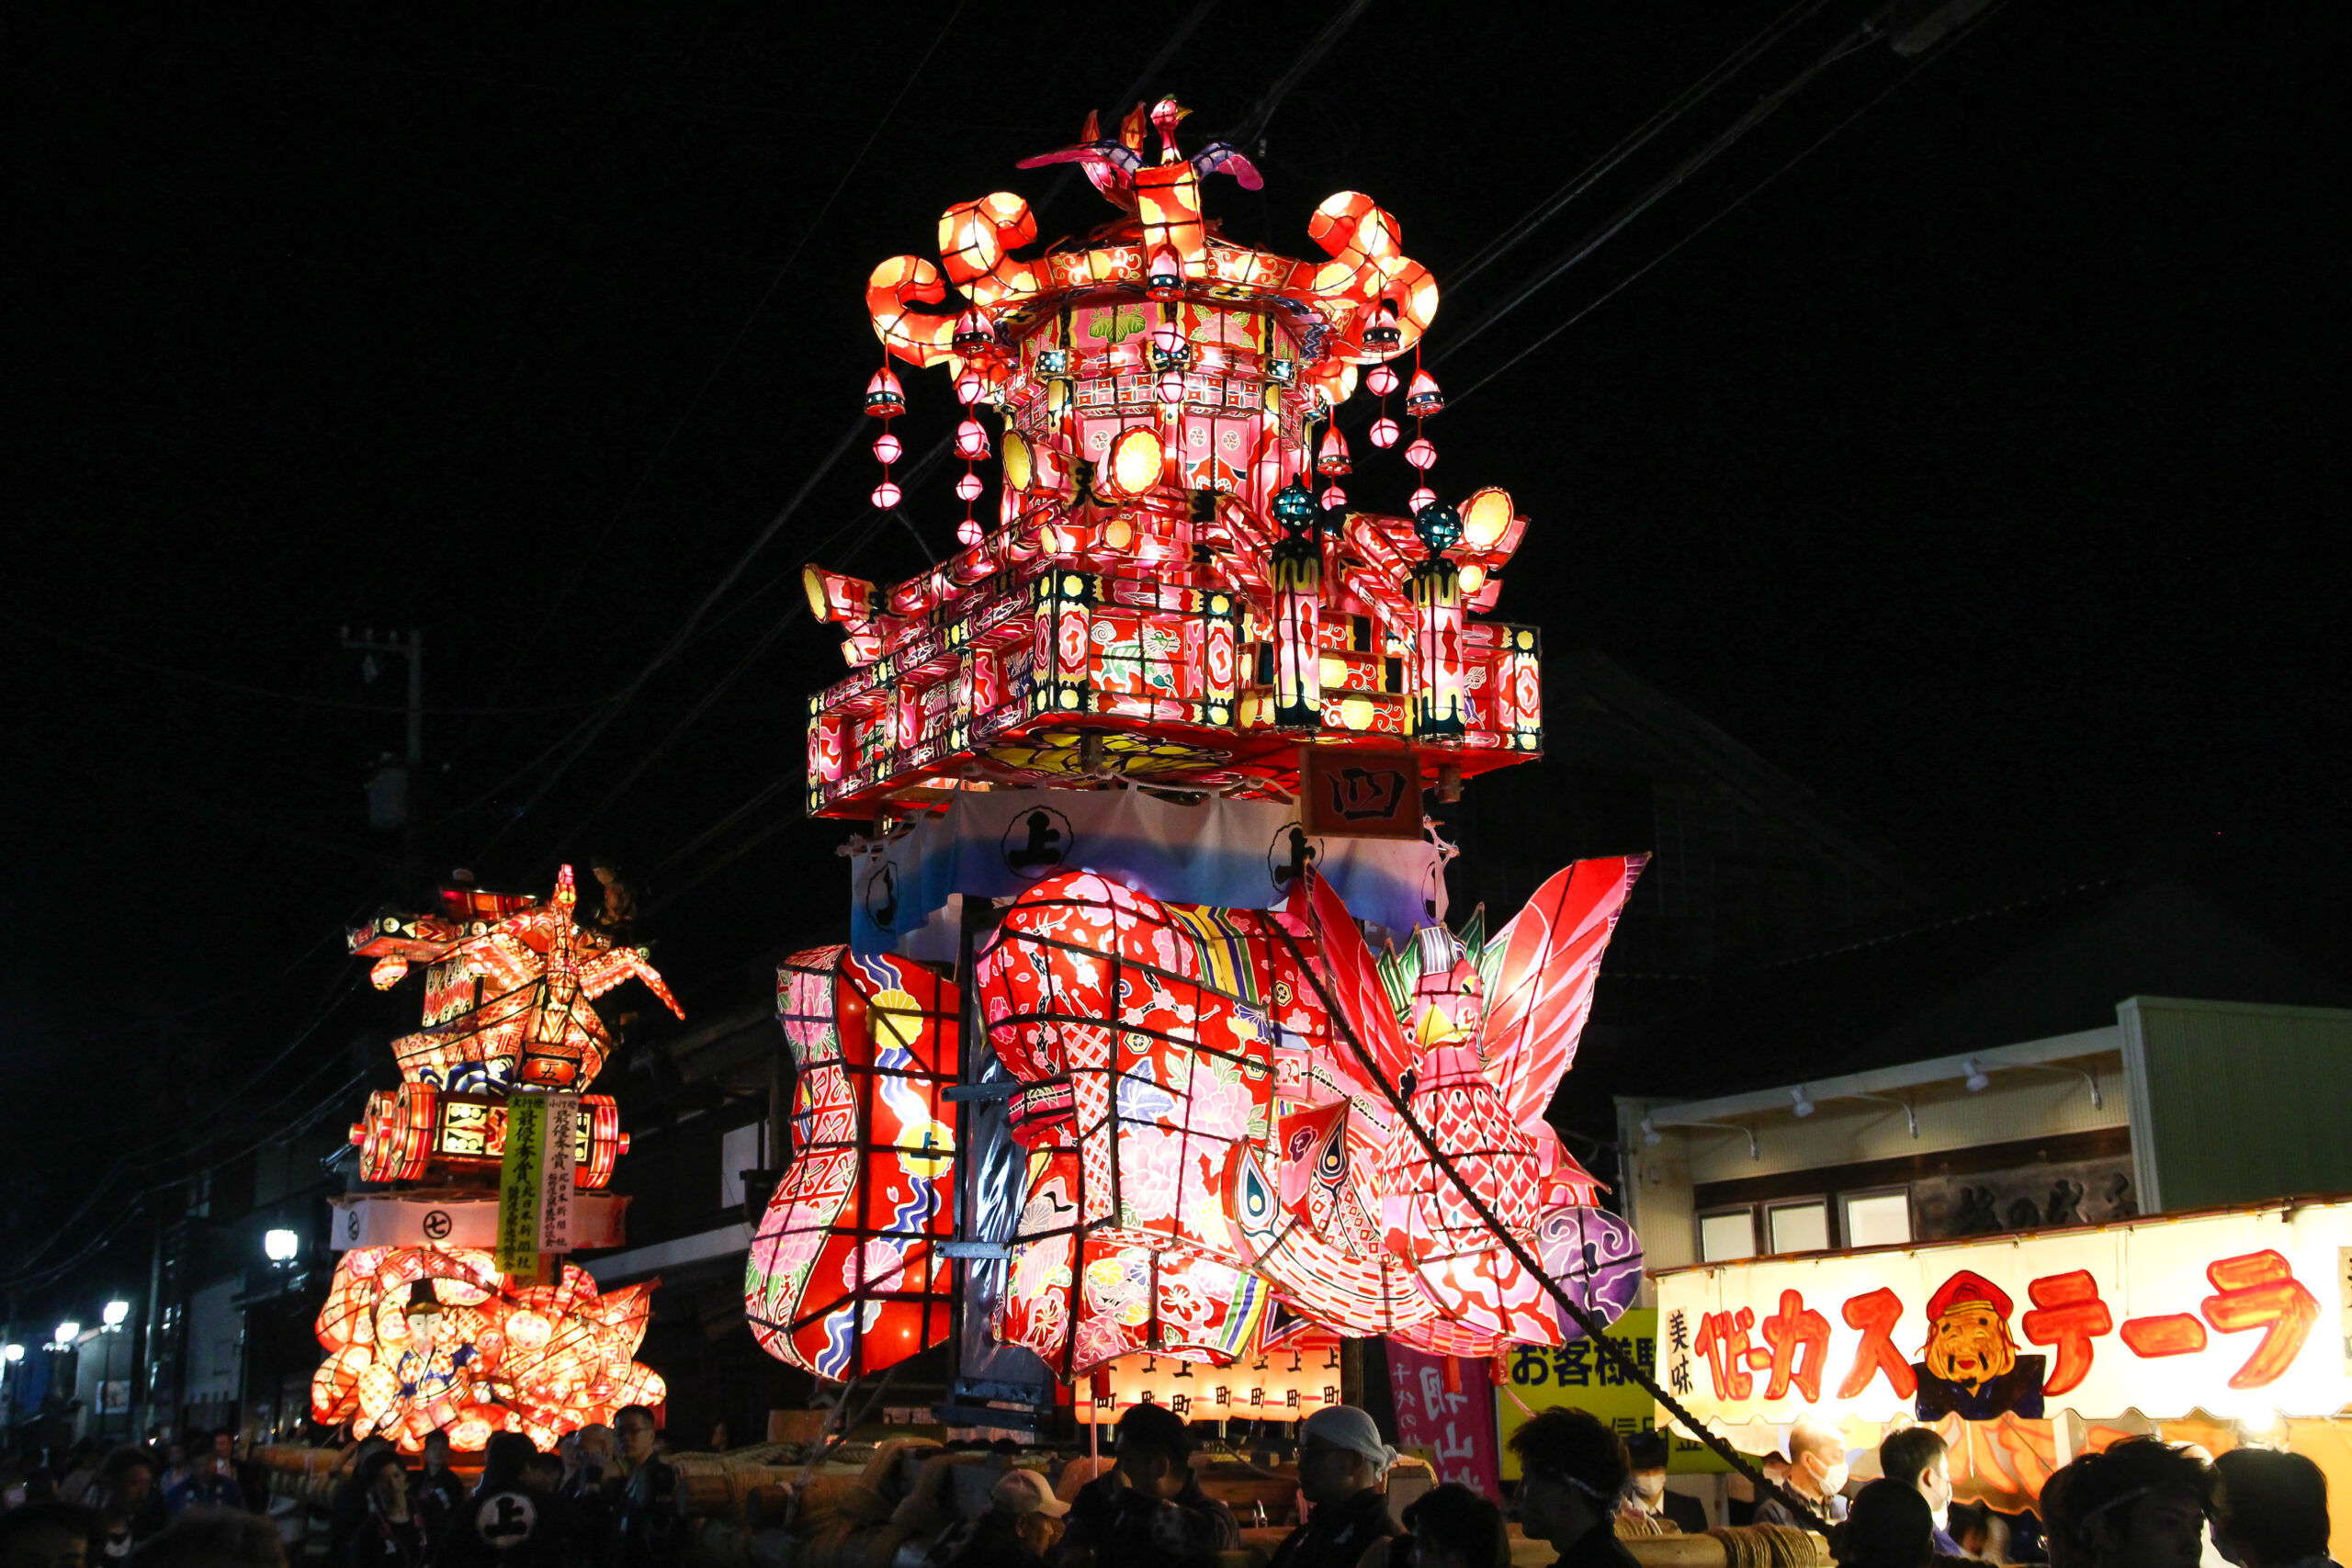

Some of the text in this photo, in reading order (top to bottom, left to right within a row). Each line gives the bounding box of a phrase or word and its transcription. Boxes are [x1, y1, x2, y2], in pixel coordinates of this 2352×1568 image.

[1325, 767, 1408, 821] 四
[1010, 810, 1062, 869] 上
[532, 1063, 561, 1084] 五
[551, 1109, 571, 1171] 最優秀賞
[425, 1215, 447, 1236] 七
[1286, 1349, 1304, 1411] 上町
[1322, 1345, 1340, 1406] 上町
[1668, 1309, 1693, 1395] 美味
[482, 1495, 528, 1540] 上
